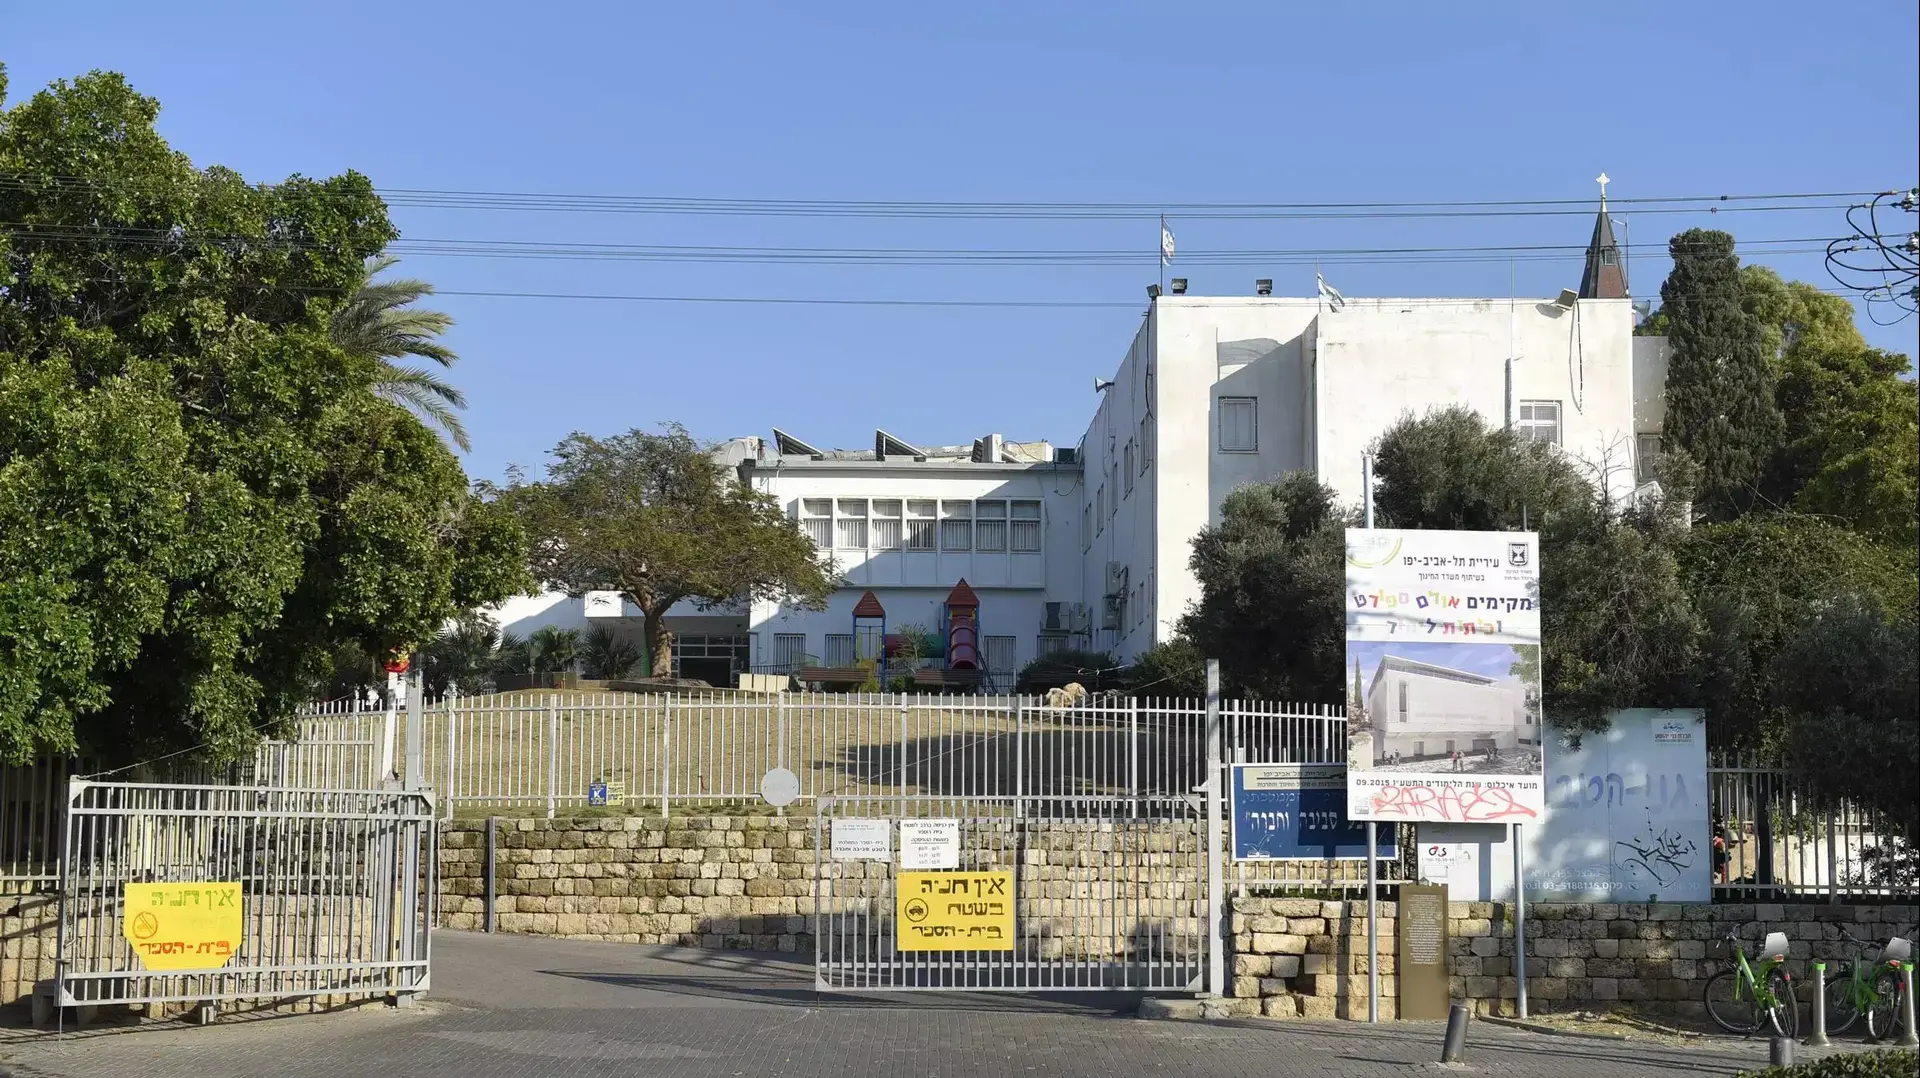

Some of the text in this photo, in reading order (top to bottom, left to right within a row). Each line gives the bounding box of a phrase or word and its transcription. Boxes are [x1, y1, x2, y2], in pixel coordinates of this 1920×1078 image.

[1403, 555, 1500, 568] עיריית תל-אביב-יפו
[1418, 573, 1485, 582] בשיתוף משרד החינוך
[1353, 589, 1533, 613] מקימים אולם ספורט
[1355, 778, 1390, 787] 09.2015
[1425, 779, 1463, 788] הלימודים
[1517, 782, 1538, 790] מועד
[921, 877, 1006, 898] אין חניה
[151, 888, 236, 911] אין חניה
[947, 902, 1005, 916] בשטח
